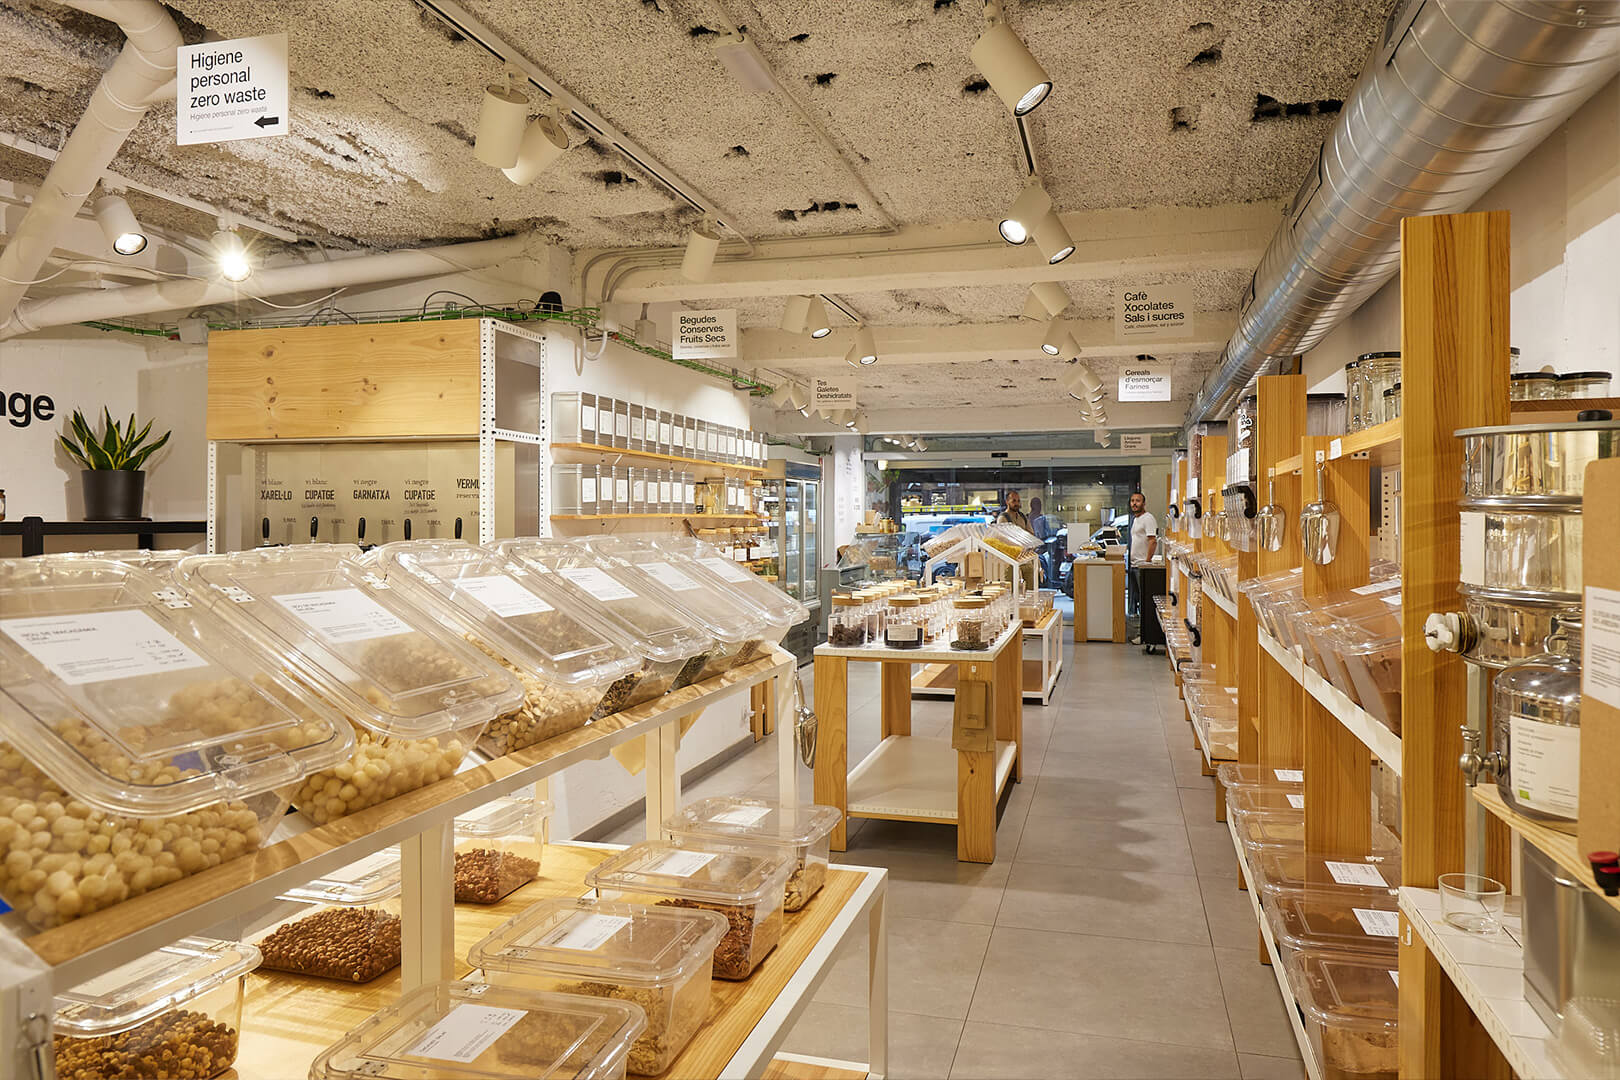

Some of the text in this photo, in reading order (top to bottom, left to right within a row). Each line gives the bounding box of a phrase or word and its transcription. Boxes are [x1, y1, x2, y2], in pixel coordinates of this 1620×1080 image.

[191, 51, 243, 71] Higiene
[190, 66, 251, 92] personal
[190, 87, 266, 109] zero waste
[190, 112, 211, 121] Higiene
[212, 109, 236, 119] personal
[237, 108, 250, 116] zero
[1124, 291, 1148, 302] Cafè
[1124, 302, 1174, 312] Xocolates
[680, 315, 717, 326] Begudes
[1124, 313, 1145, 323] Sals
[1152, 312, 1185, 321] sucres
[680, 325, 724, 334] Conserves
[680, 334, 726, 343] Fruits Secs
[0, 390, 55, 428] ge
[304, 490, 335, 500] CUPATGE
[353, 490, 390, 500] GARNATXA
[404, 490, 436, 500] CUPATGE
